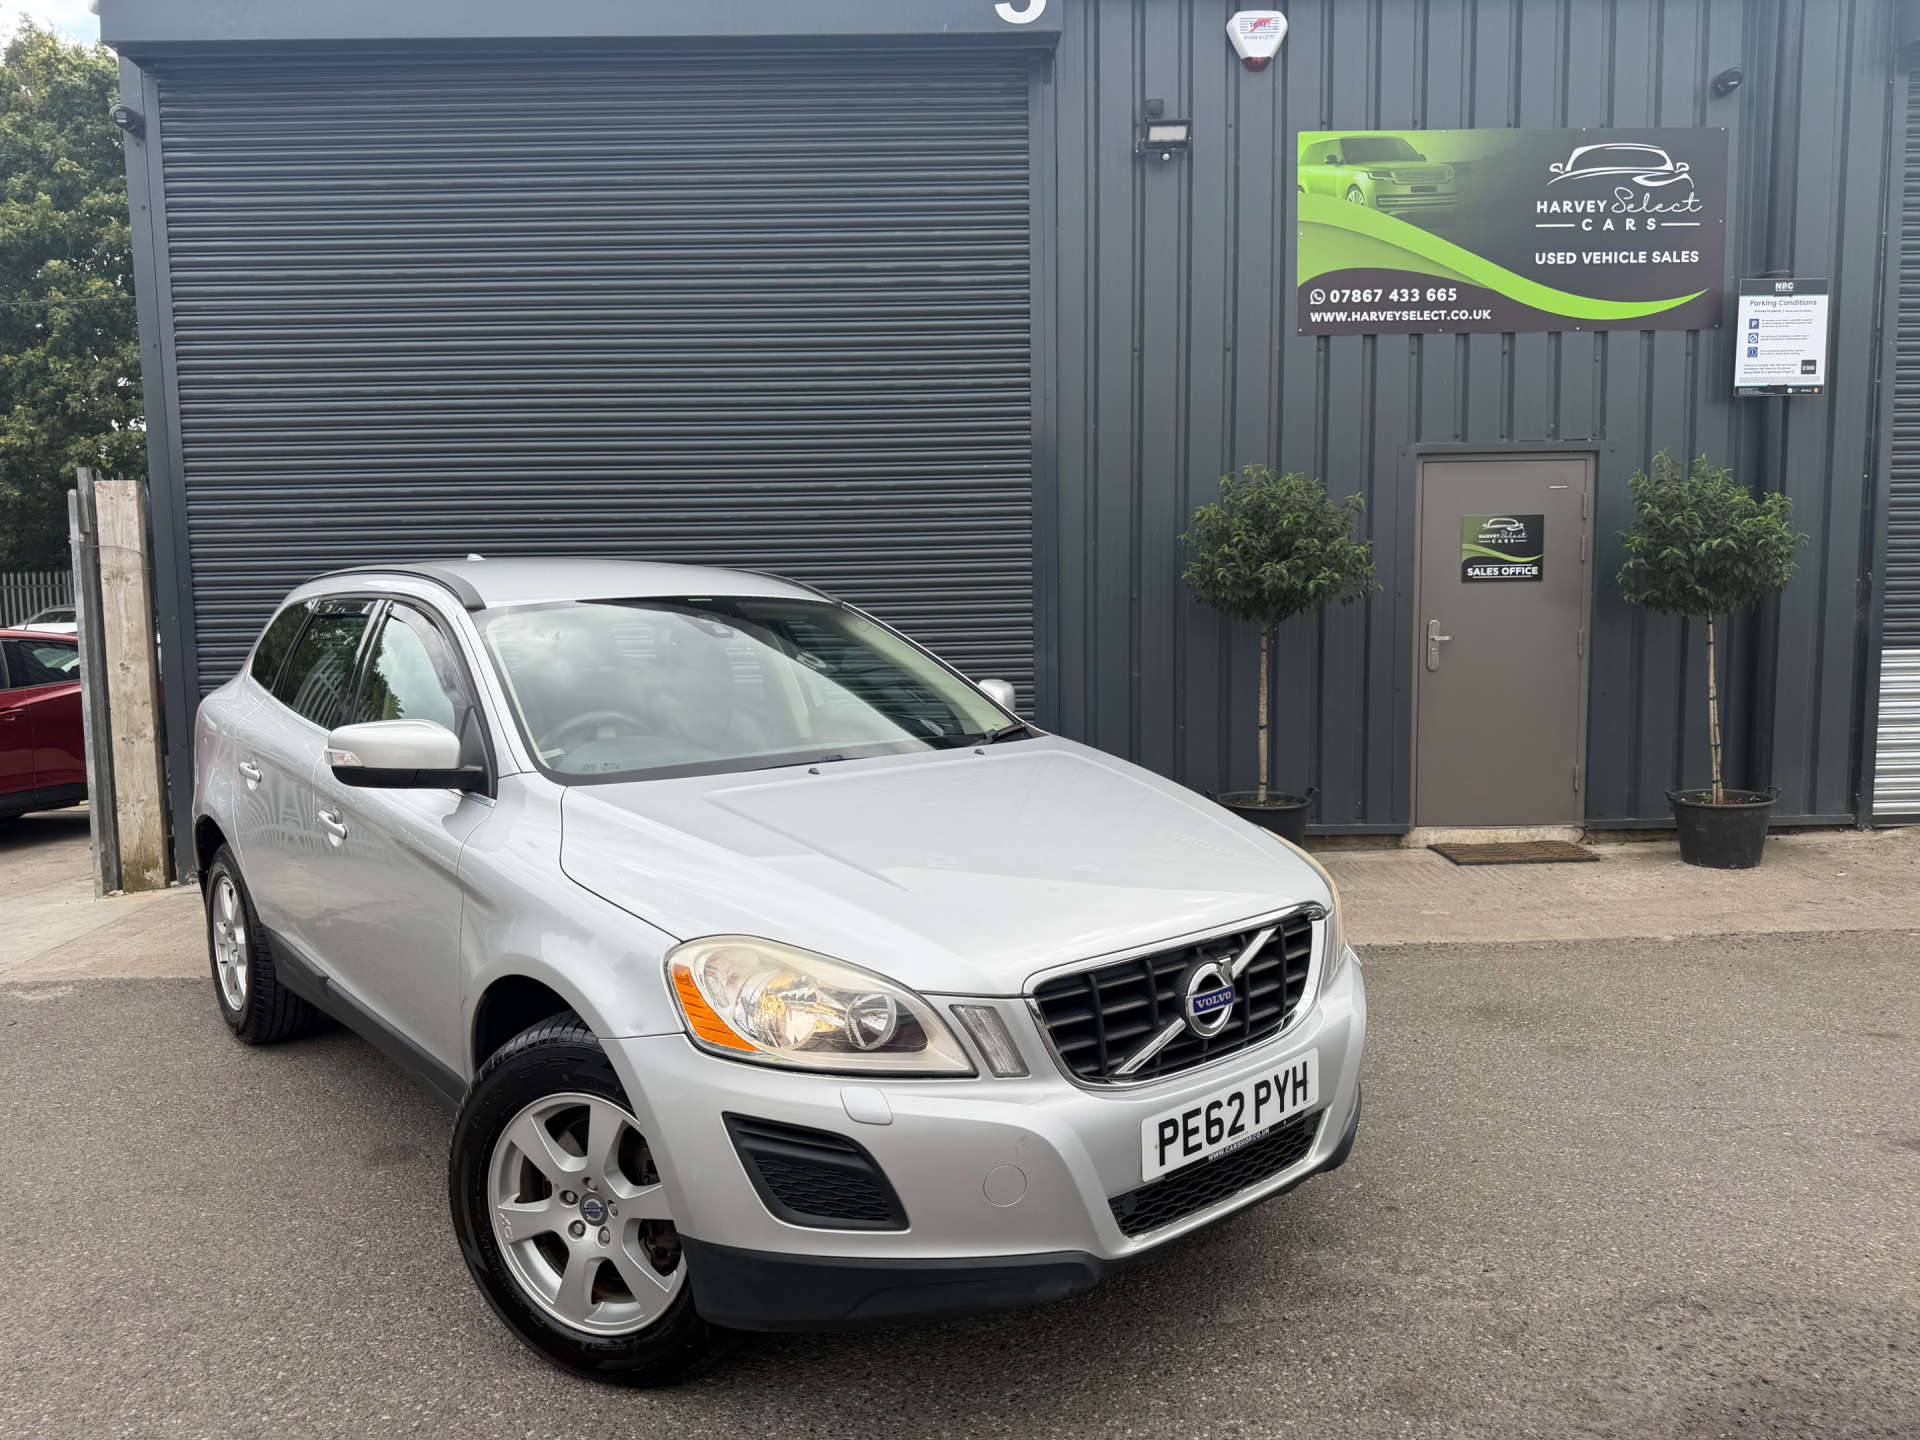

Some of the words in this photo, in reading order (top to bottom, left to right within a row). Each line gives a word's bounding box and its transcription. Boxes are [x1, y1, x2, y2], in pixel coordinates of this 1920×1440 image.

[1536, 200, 1607, 213] HARVEY
[1611, 186, 1703, 213] Select
[1581, 218, 1657, 231] CARS
[1535, 252, 1577, 265] USED
[1582, 251, 1647, 264] VEHICLE
[1651, 250, 1699, 263] SALES
[1329, 289, 1383, 303] 07867
[1389, 288, 1420, 302] 433
[1426, 288, 1457, 301] 665
[1310, 309, 1491, 322] WWW.HARVEYSELECT.CO.UK
[1467, 567, 1499, 576] SALES
[1501, 566, 1538, 576] OFFICE
[1196, 991, 1231, 1008] VOLVO
[1158, 1091, 1246, 1167] PE62
[1254, 1061, 1309, 1126] PYH
